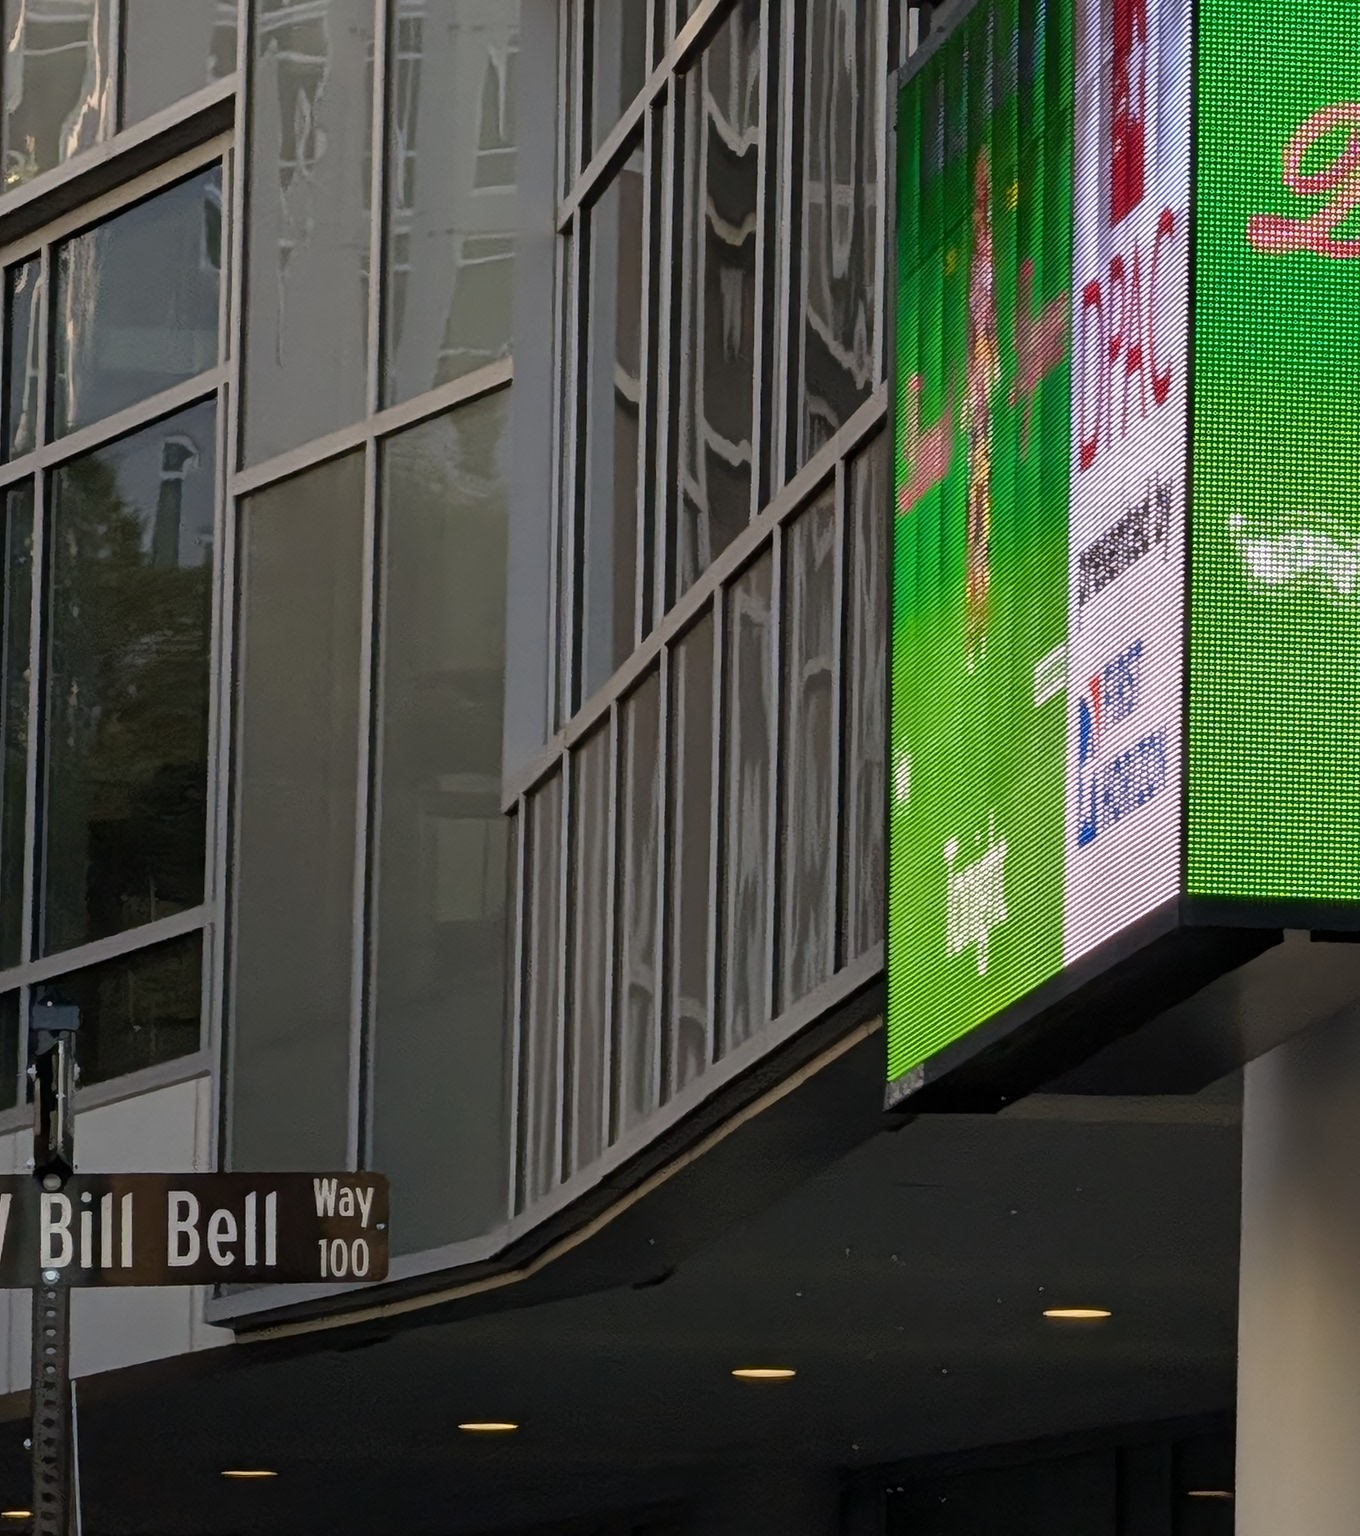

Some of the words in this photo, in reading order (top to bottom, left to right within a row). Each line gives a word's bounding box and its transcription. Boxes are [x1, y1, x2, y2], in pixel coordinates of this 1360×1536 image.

[40, 1190, 134, 1268] Bill
[167, 1190, 277, 1267] Bell
[313, 1177, 374, 1229] Way
[318, 1237, 370, 1278] 100
